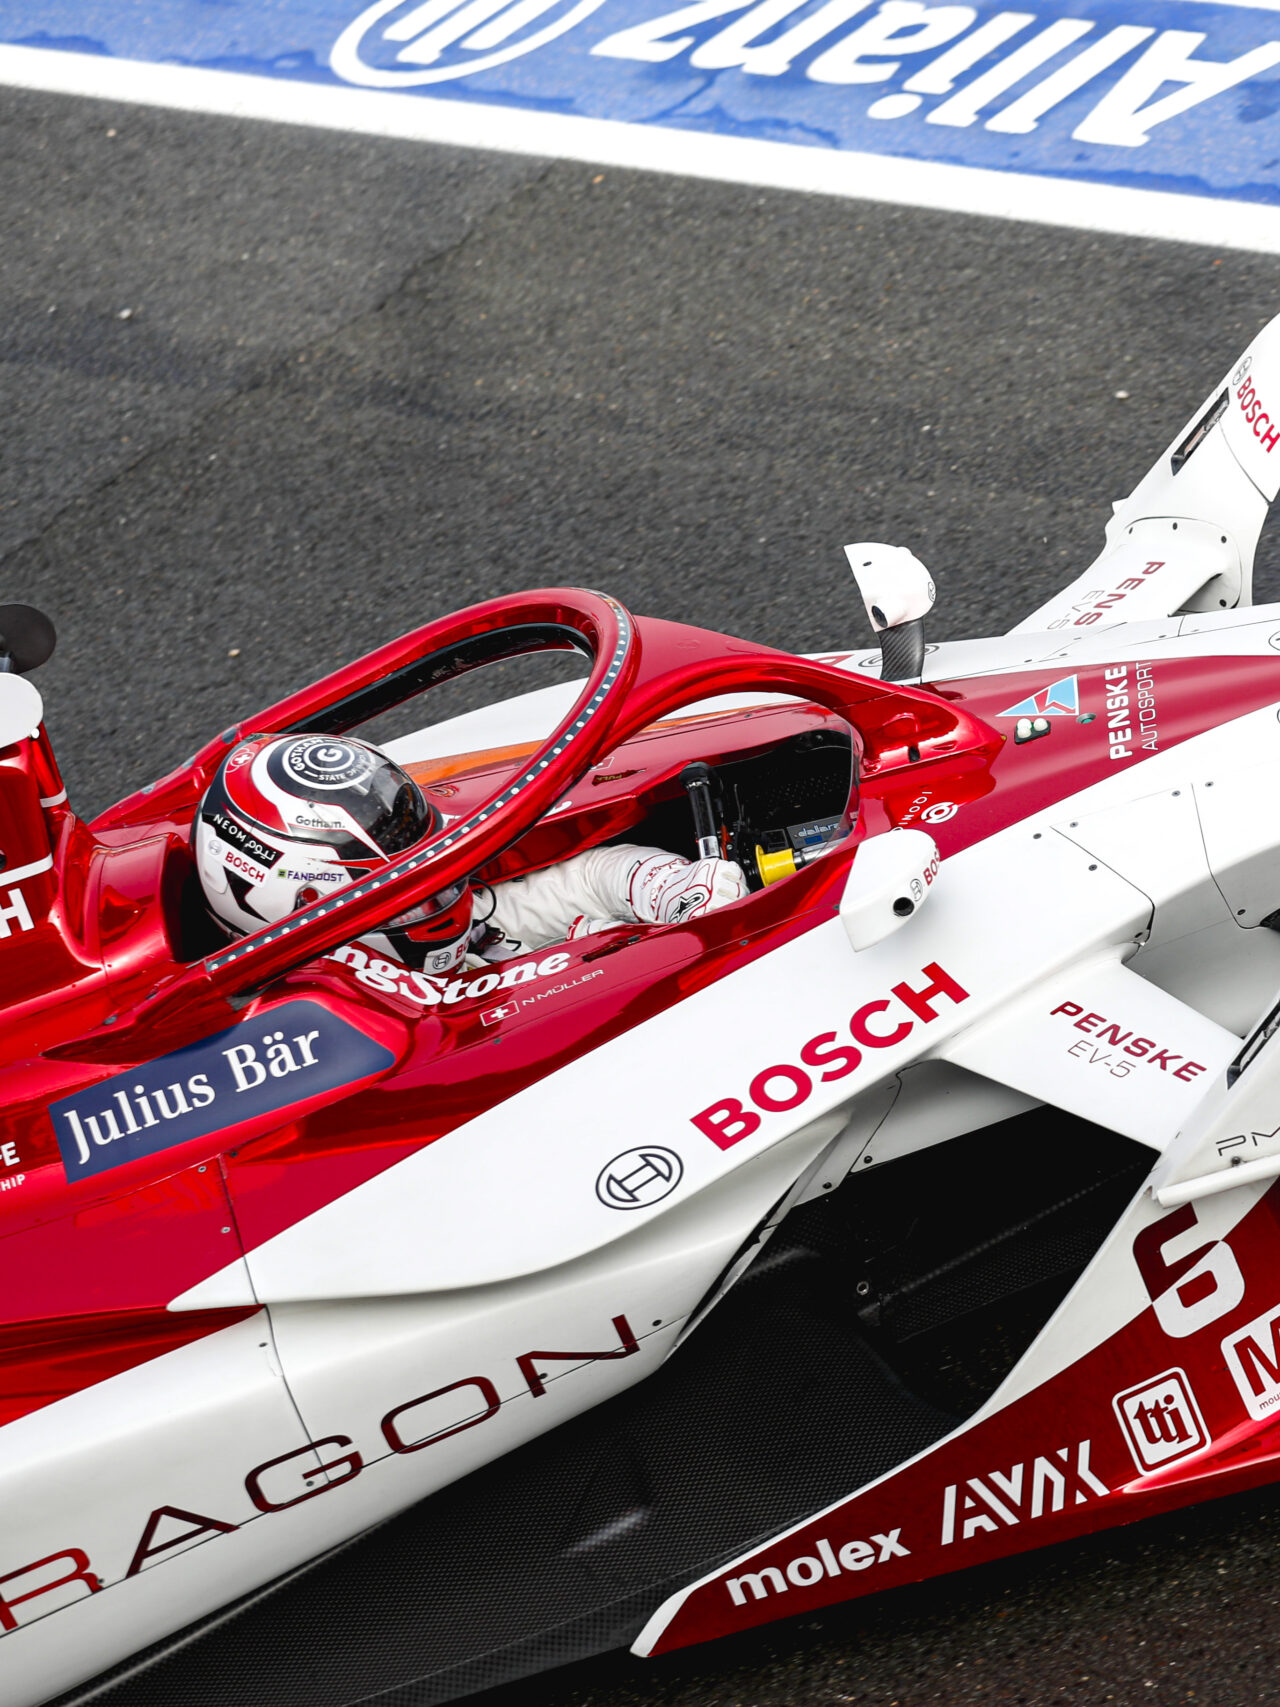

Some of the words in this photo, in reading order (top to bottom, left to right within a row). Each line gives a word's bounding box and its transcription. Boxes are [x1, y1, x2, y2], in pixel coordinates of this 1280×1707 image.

[1237, 376, 1280, 453] BOSCH
[1104, 665, 1133, 760] PENSKE
[1136, 661, 1159, 751] AUTOSPORT
[213, 813, 247, 842] NEOM
[225, 851, 265, 883] BOSCH
[287, 870, 344, 883] FANBOOST
[321, 945, 571, 1006] ngStone
[522, 998, 535, 1006] N
[537, 969, 604, 997] MÜLLER
[689, 961, 970, 1151] BOSCH
[1050, 1001, 1207, 1083] PENSKE
[1067, 1040, 1136, 1078] EV-5
[63, 1074, 216, 1165] Julius
[222, 1031, 320, 1092] Bär
[0, 1173, 26, 1192] HIP
[1132, 1202, 1246, 1339] 6
[1133, 1394, 1193, 1445] tti
[0, 1314, 641, 1632] RAGON
[724, 1526, 911, 1607] molex
